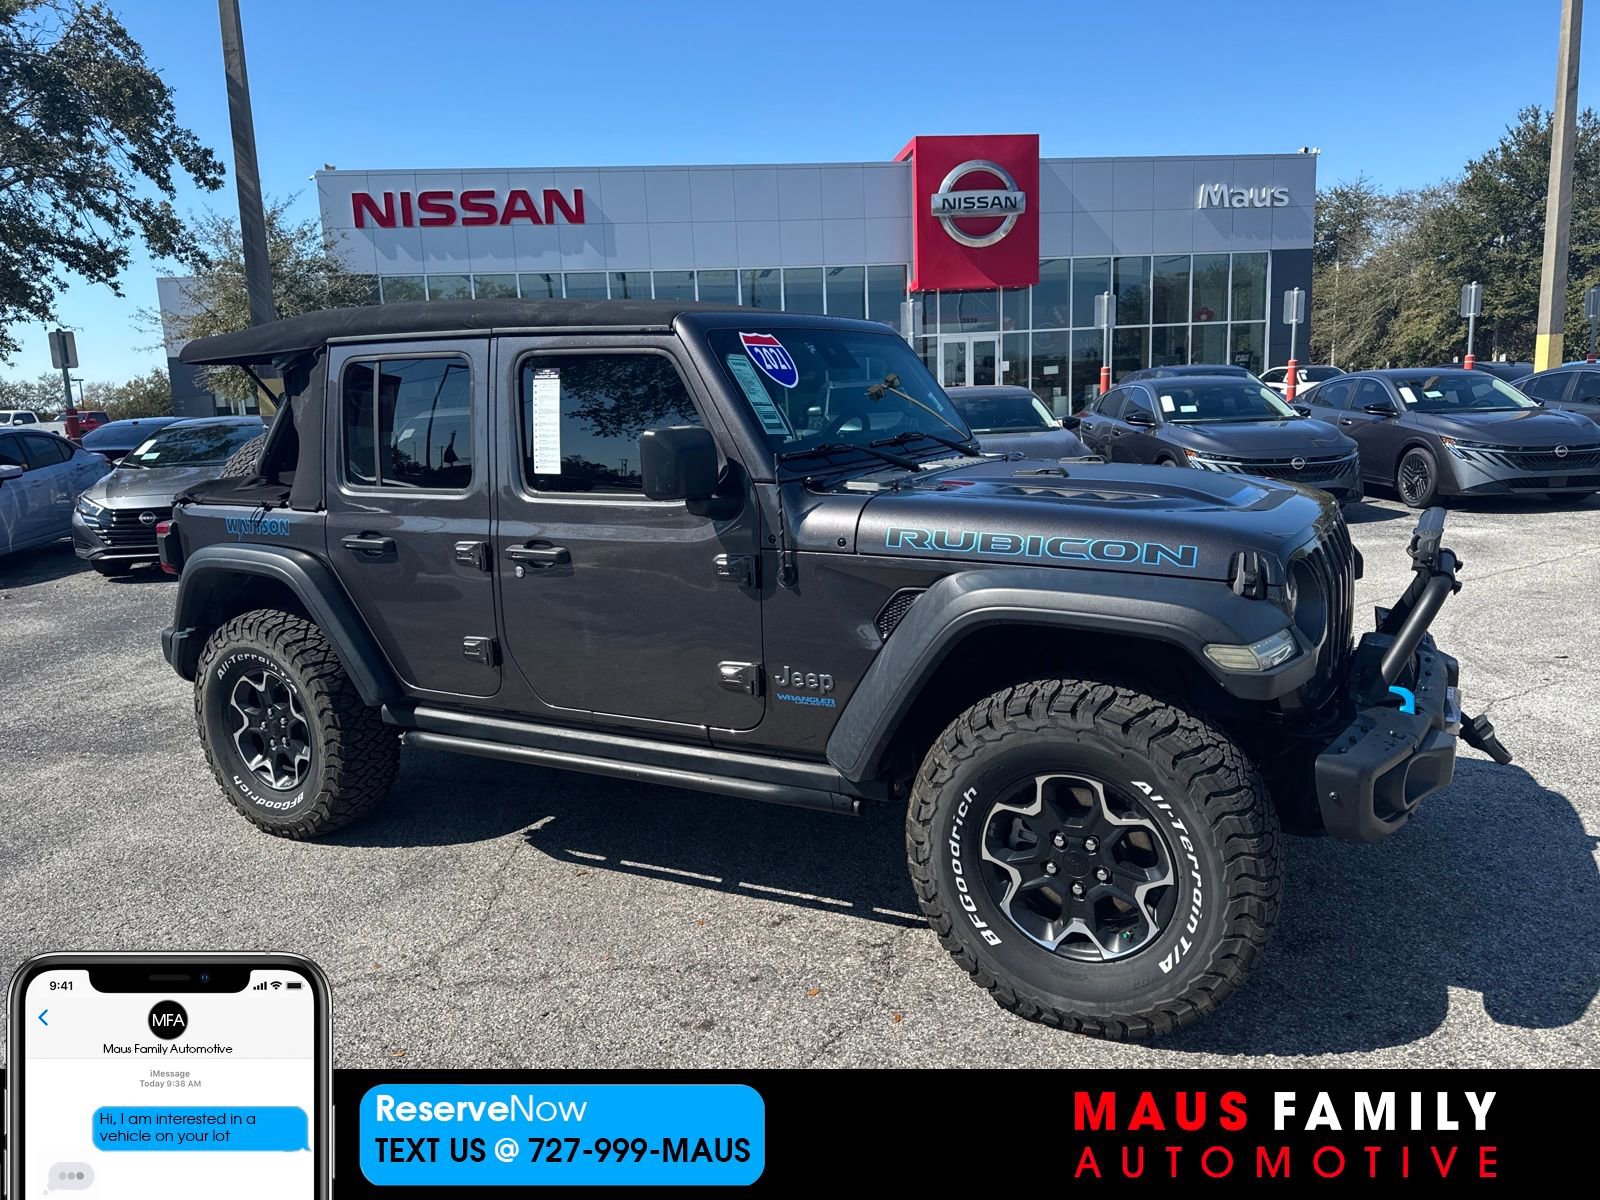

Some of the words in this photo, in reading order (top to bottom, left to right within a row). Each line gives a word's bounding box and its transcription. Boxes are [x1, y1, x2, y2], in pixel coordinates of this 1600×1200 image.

[351, 188, 585, 229] NISSAN
[941, 195, 1017, 210] NISSAN
[1199, 183, 1290, 209] Maus
[753, 346, 793, 370] 2021
[885, 526, 1198, 568] RUBICON
[216, 653, 278, 681] All-Terrain
[774, 665, 834, 694] Jeep
[776, 692, 837, 705] WRANGLER
[233, 774, 304, 811] BFGoodrich
[948, 786, 1003, 946] BFGoodrich
[1130, 780, 1203, 935] All-Terrain
[1157, 938, 1193, 974] T/A
